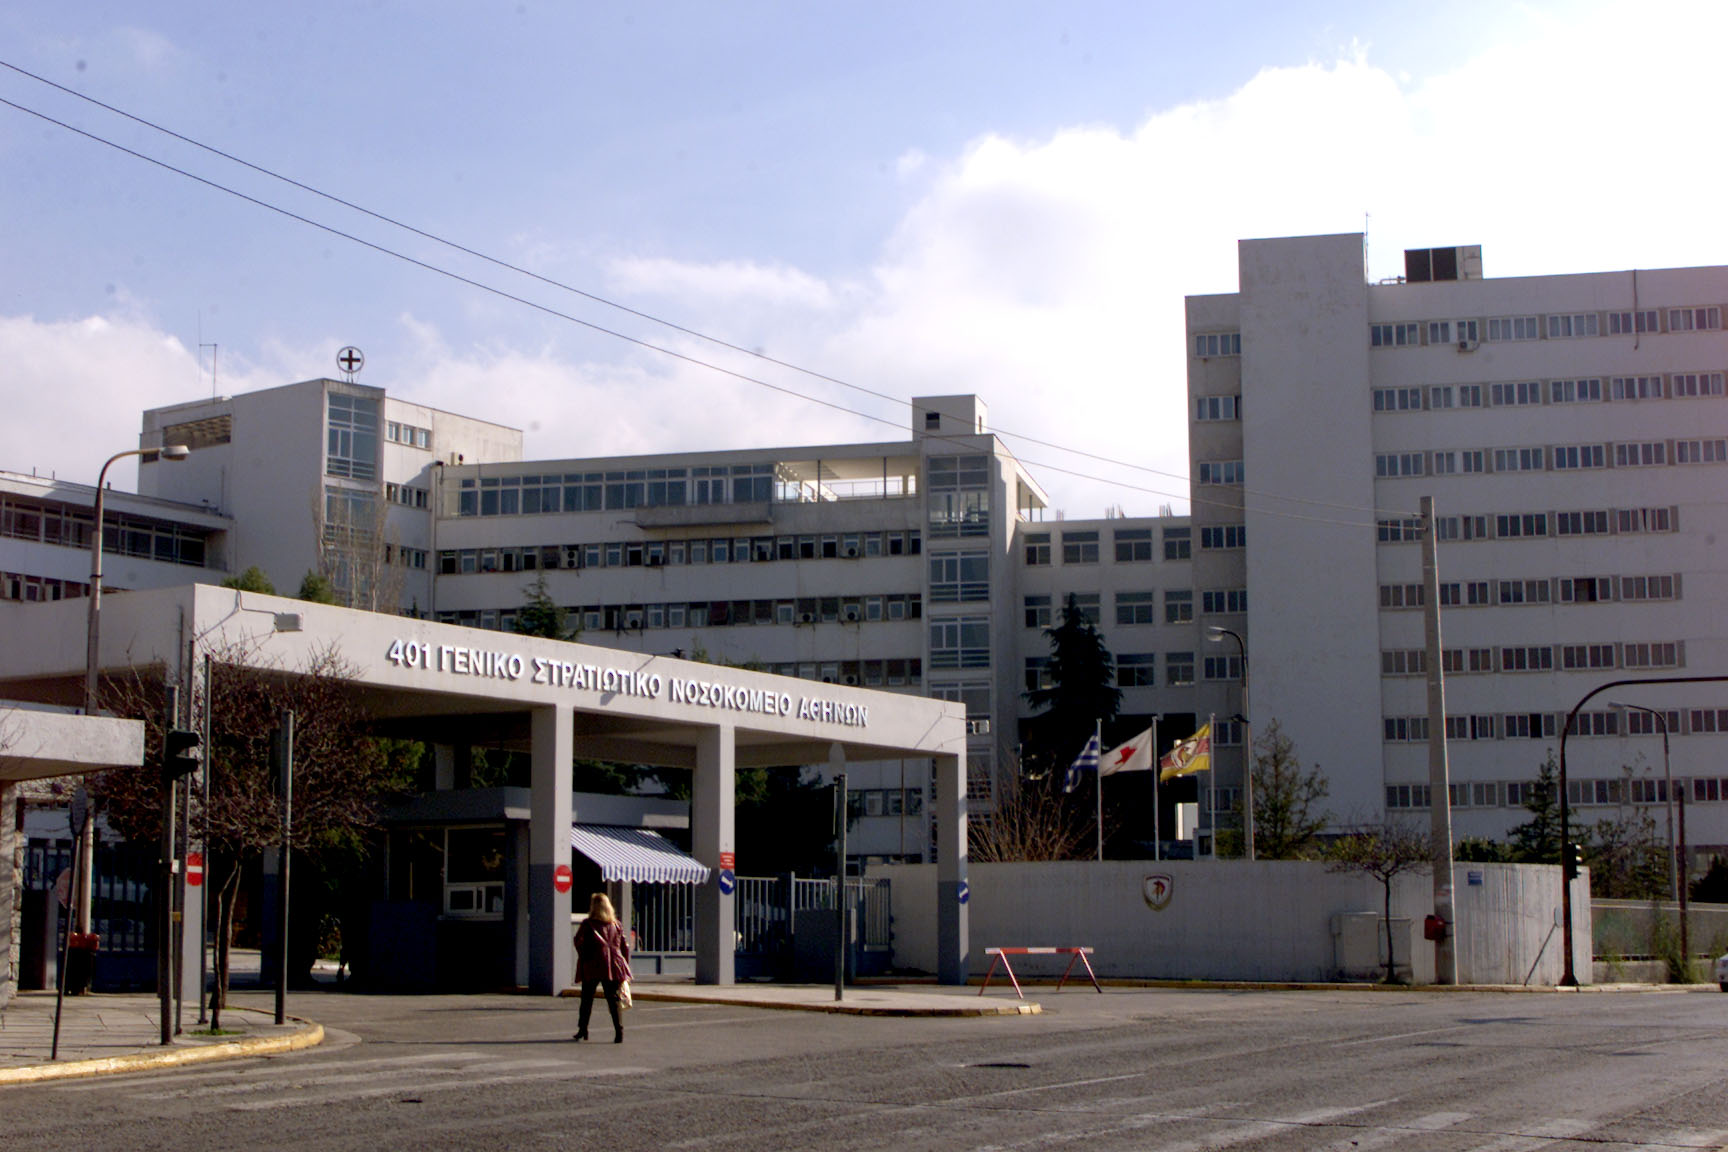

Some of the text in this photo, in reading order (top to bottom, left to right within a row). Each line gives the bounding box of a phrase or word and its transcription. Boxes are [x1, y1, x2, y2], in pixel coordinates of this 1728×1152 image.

[387, 639, 869, 727] 401 ΓΕΝΙΚΟ ΣΤΡΑΤΙΩΤΙΚΟ ΝΟΣΟΚΟΜΕΙΟ ΑΘΗΝΩΝ
